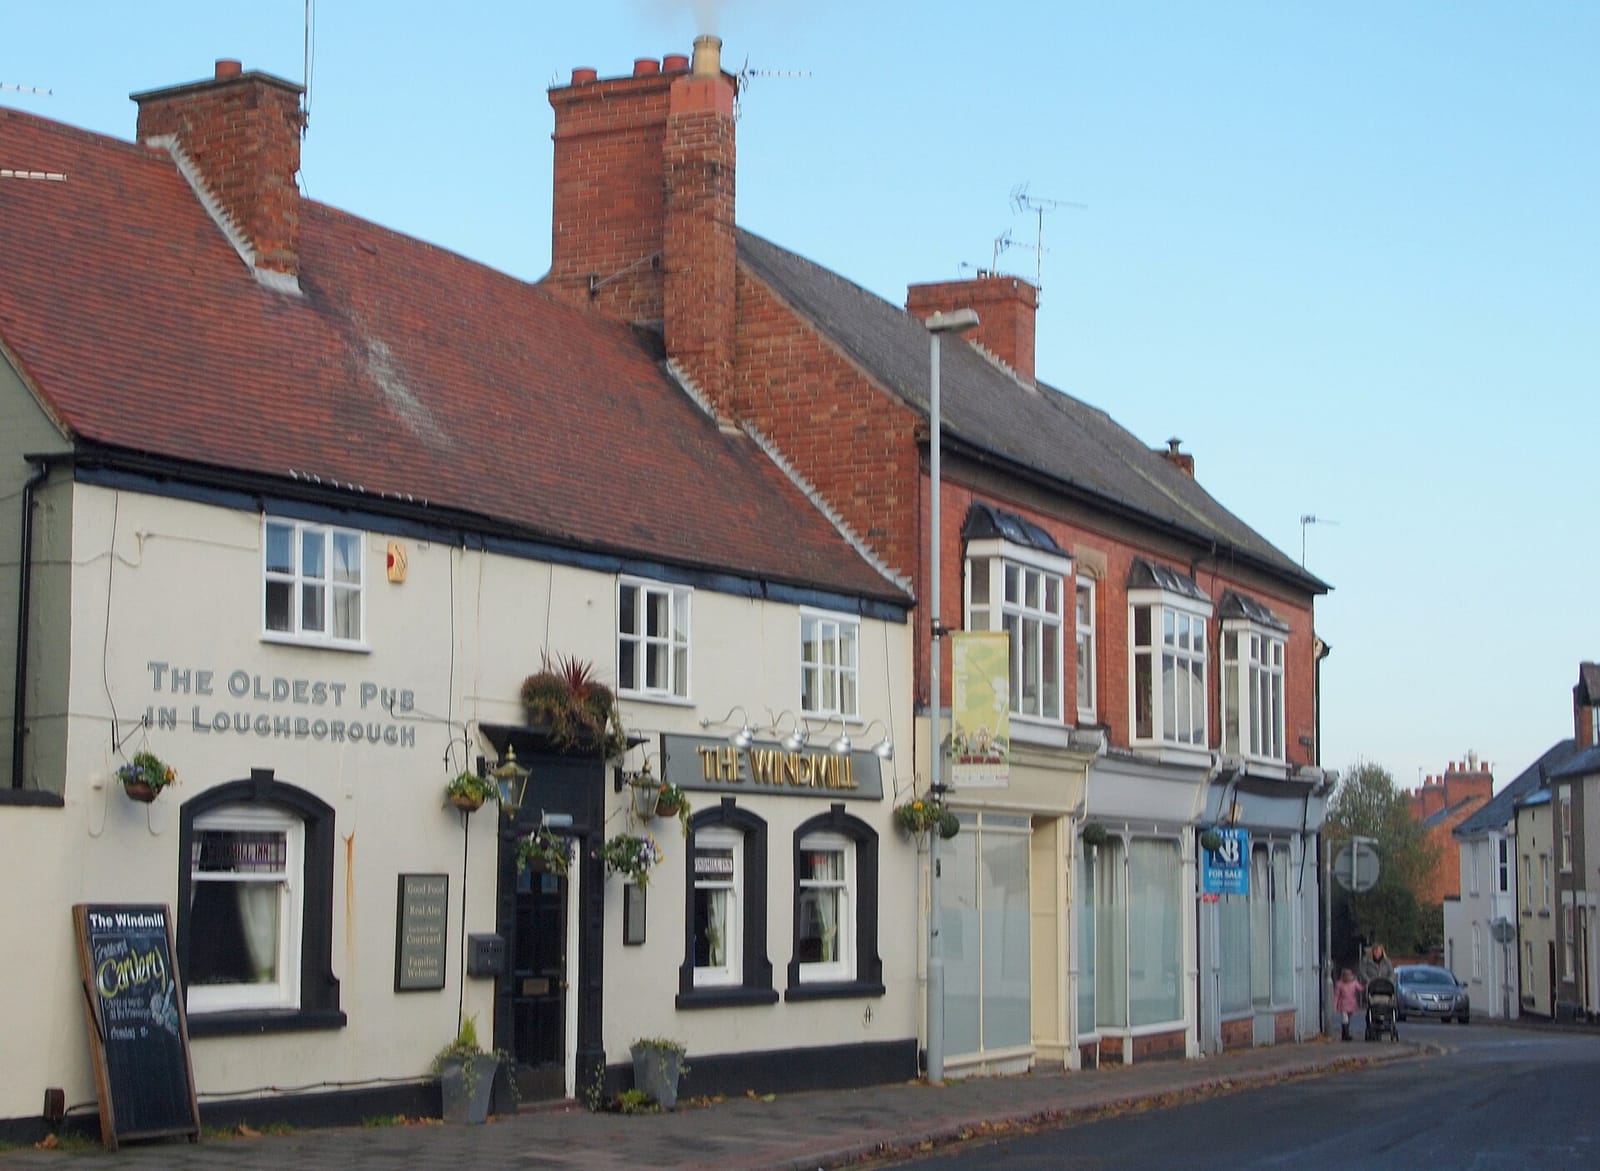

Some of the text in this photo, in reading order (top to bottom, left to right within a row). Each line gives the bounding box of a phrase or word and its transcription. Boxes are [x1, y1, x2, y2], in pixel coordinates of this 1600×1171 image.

[696, 744, 859, 790] THE WINDMILL
[1208, 869, 1243, 880] FOR SALE
[89, 913, 165, 929] The Windmill
[406, 935, 441, 946] Courtyard
[409, 957, 438, 968] Families
[97, 947, 168, 999] Carvery
[407, 967, 439, 978] Welcome
